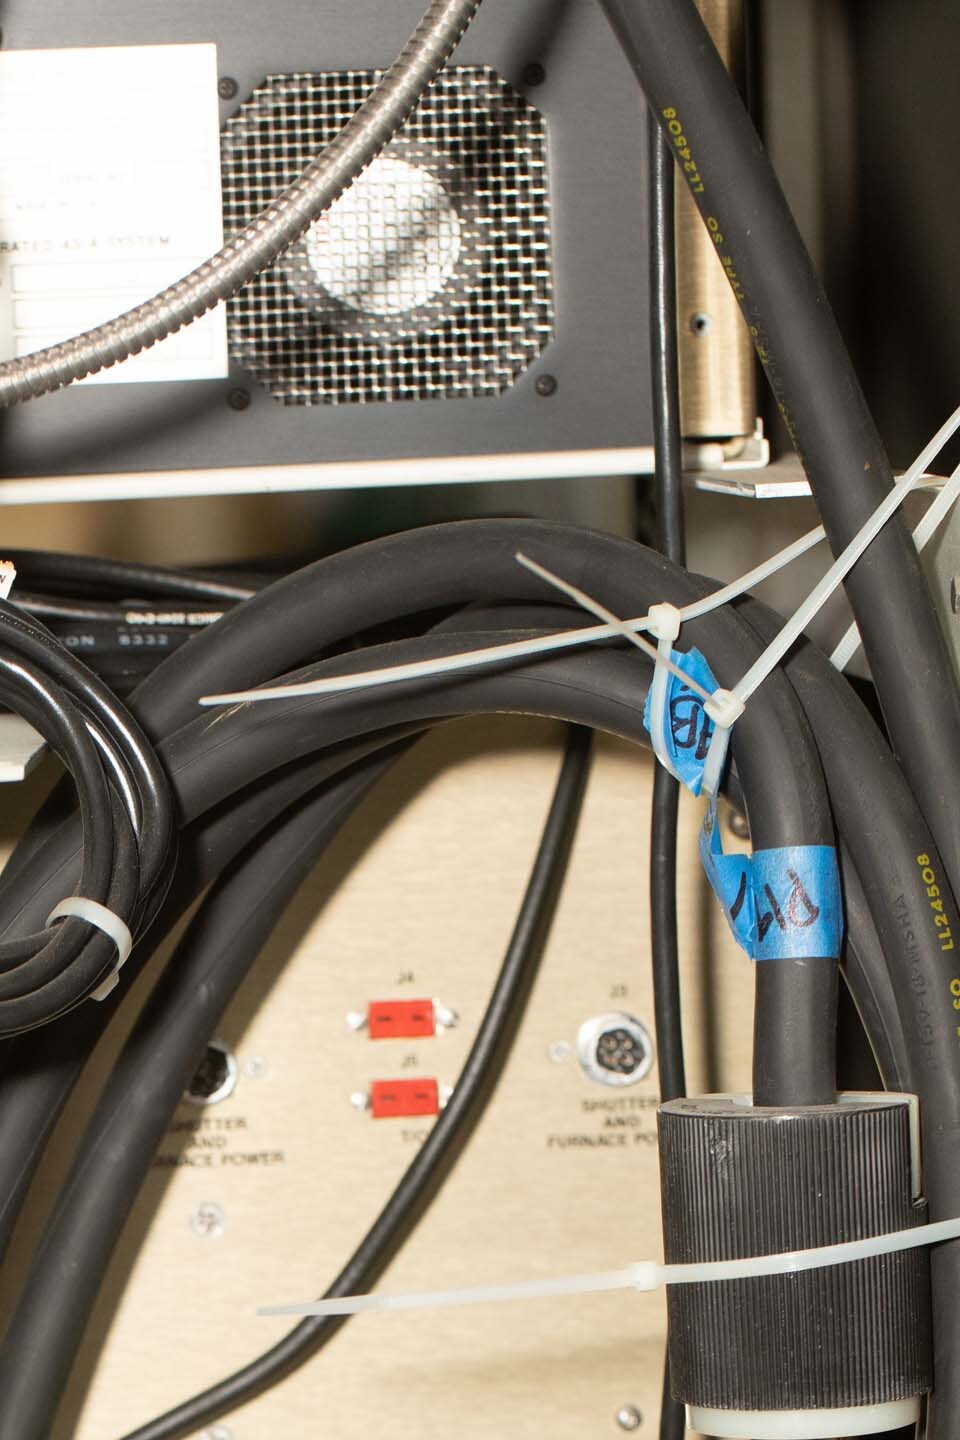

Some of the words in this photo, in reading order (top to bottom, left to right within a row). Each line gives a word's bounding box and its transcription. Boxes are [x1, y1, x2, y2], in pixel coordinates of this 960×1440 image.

[663, 107, 705, 193] LL24508
[916, 853, 954, 951] LL24508
[221, 1151, 285, 1166] POWER
